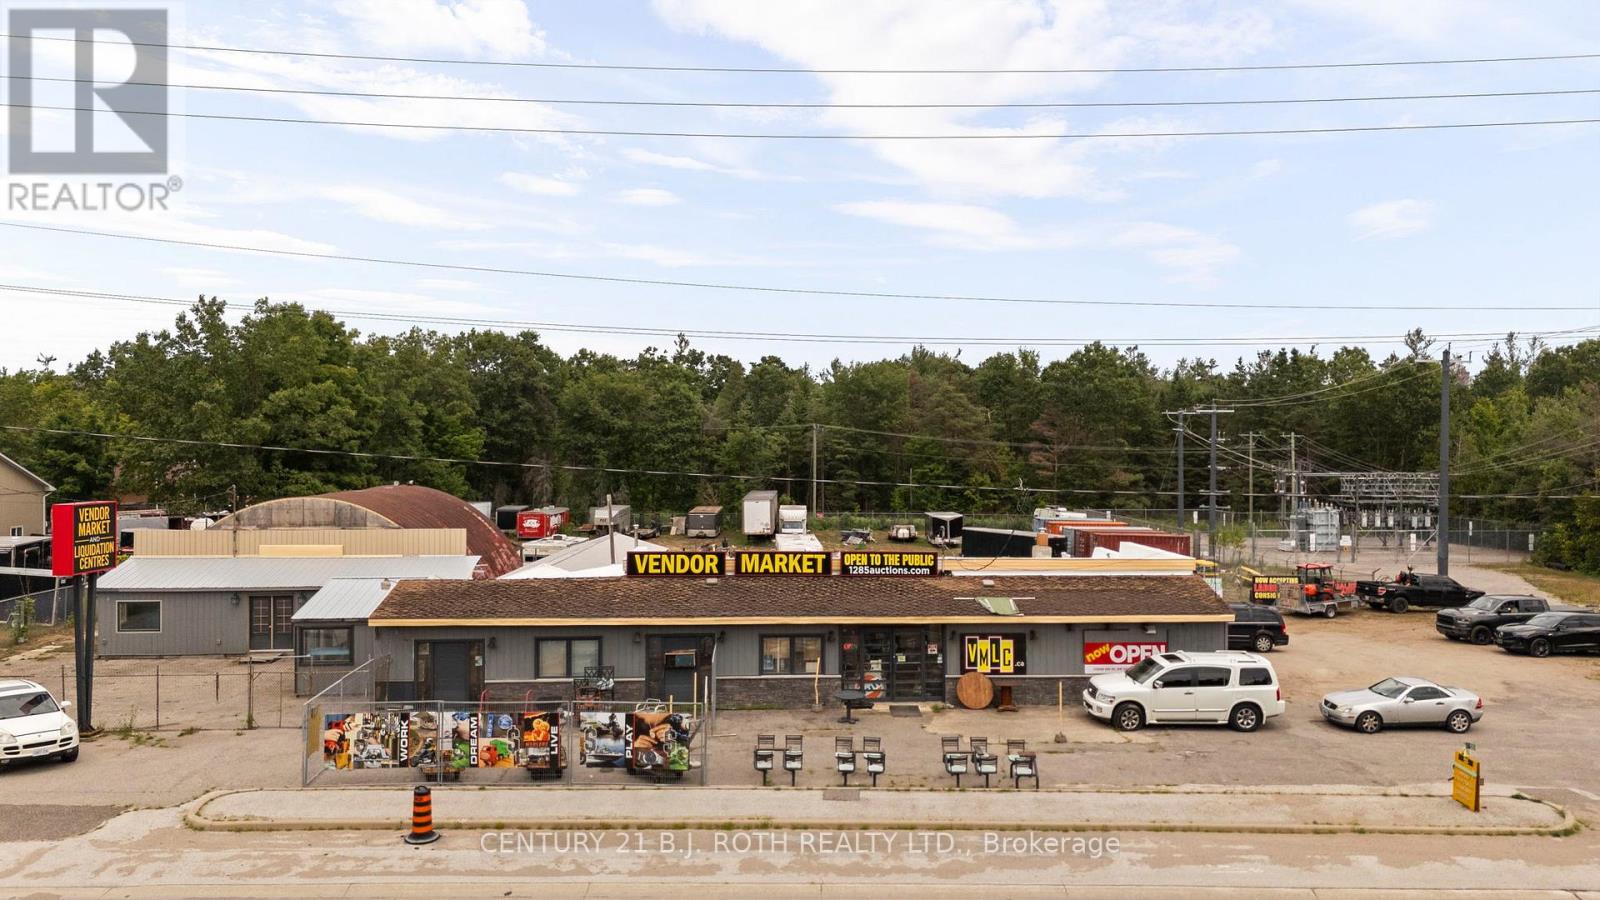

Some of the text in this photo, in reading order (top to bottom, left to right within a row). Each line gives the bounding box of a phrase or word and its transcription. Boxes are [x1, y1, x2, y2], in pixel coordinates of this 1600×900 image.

[79, 506, 110, 522] VENDOR
[78, 520, 110, 537] MARKET
[74, 541, 115, 558] LIQUIDATION
[79, 554, 110, 570] CENTRES
[634, 553, 826, 574] VENDOR MARKET
[844, 554, 935, 566] OPEN TO THE PUBLIC
[849, 566, 931, 575] 1285auctions.com
[967, 643, 1011, 667] VMLC
[1085, 643, 1110, 662] now
[400, 719, 409, 762] WORK
[470, 716, 478, 765] DREAM
[625, 724, 633, 759] PLAY
